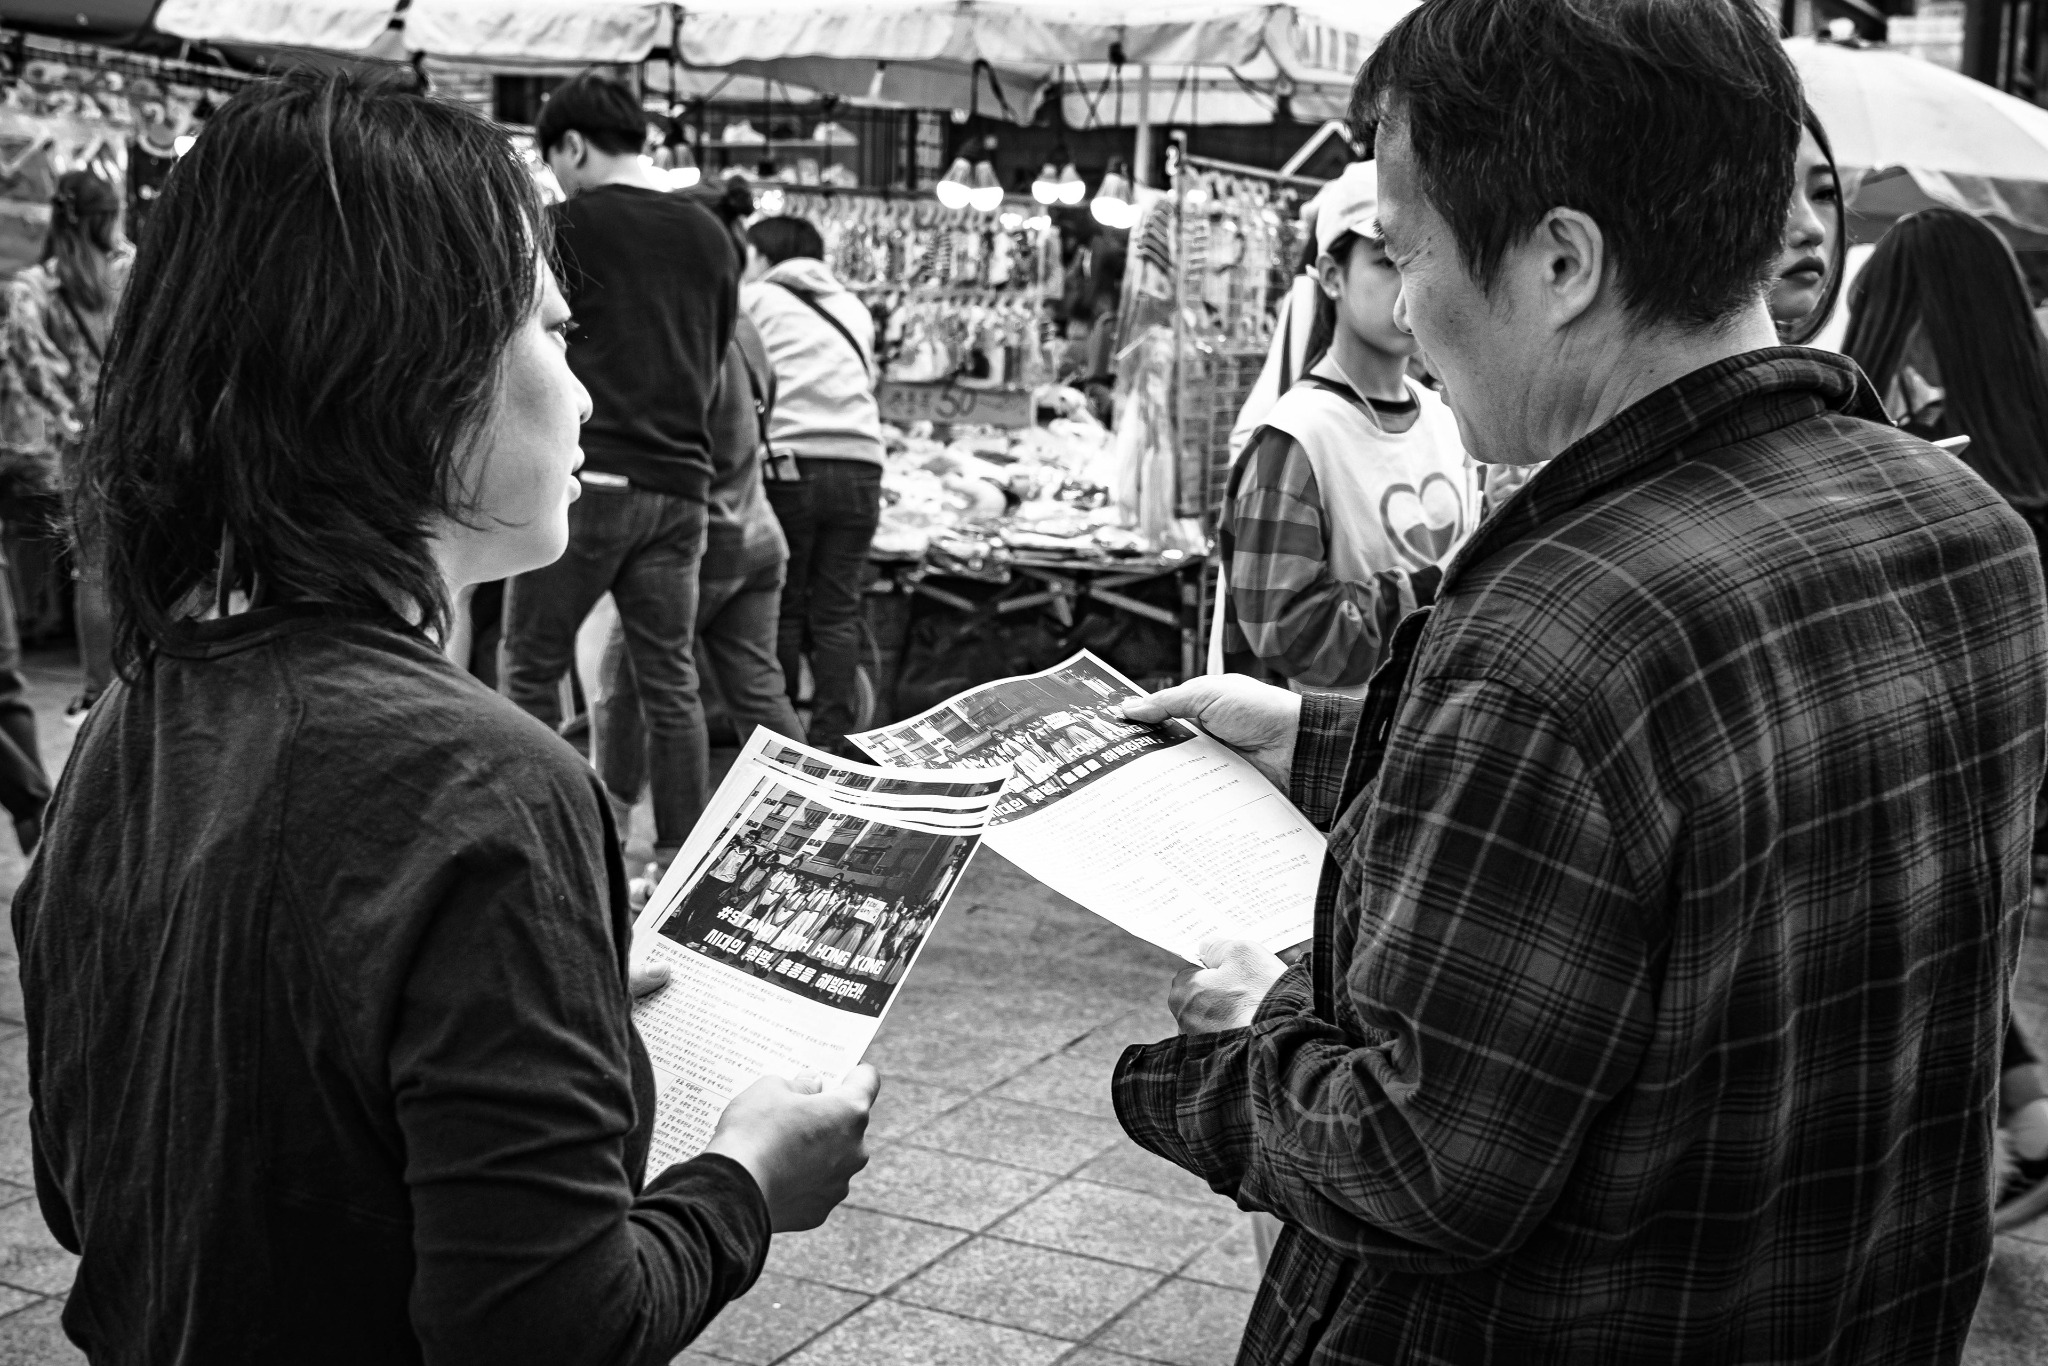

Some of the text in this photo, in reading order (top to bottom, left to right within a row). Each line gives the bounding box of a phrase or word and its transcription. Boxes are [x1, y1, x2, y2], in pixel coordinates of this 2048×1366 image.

[703, 928, 747, 955] 시대의
[741, 945, 772, 969] 혁명,
[774, 958, 817, 984] 홍콩을
[814, 972, 868, 1001] 해방하라!
[716, 906, 778, 943] #STAND
[811, 943, 852, 967] HONG
[849, 954, 886, 975] KONG
